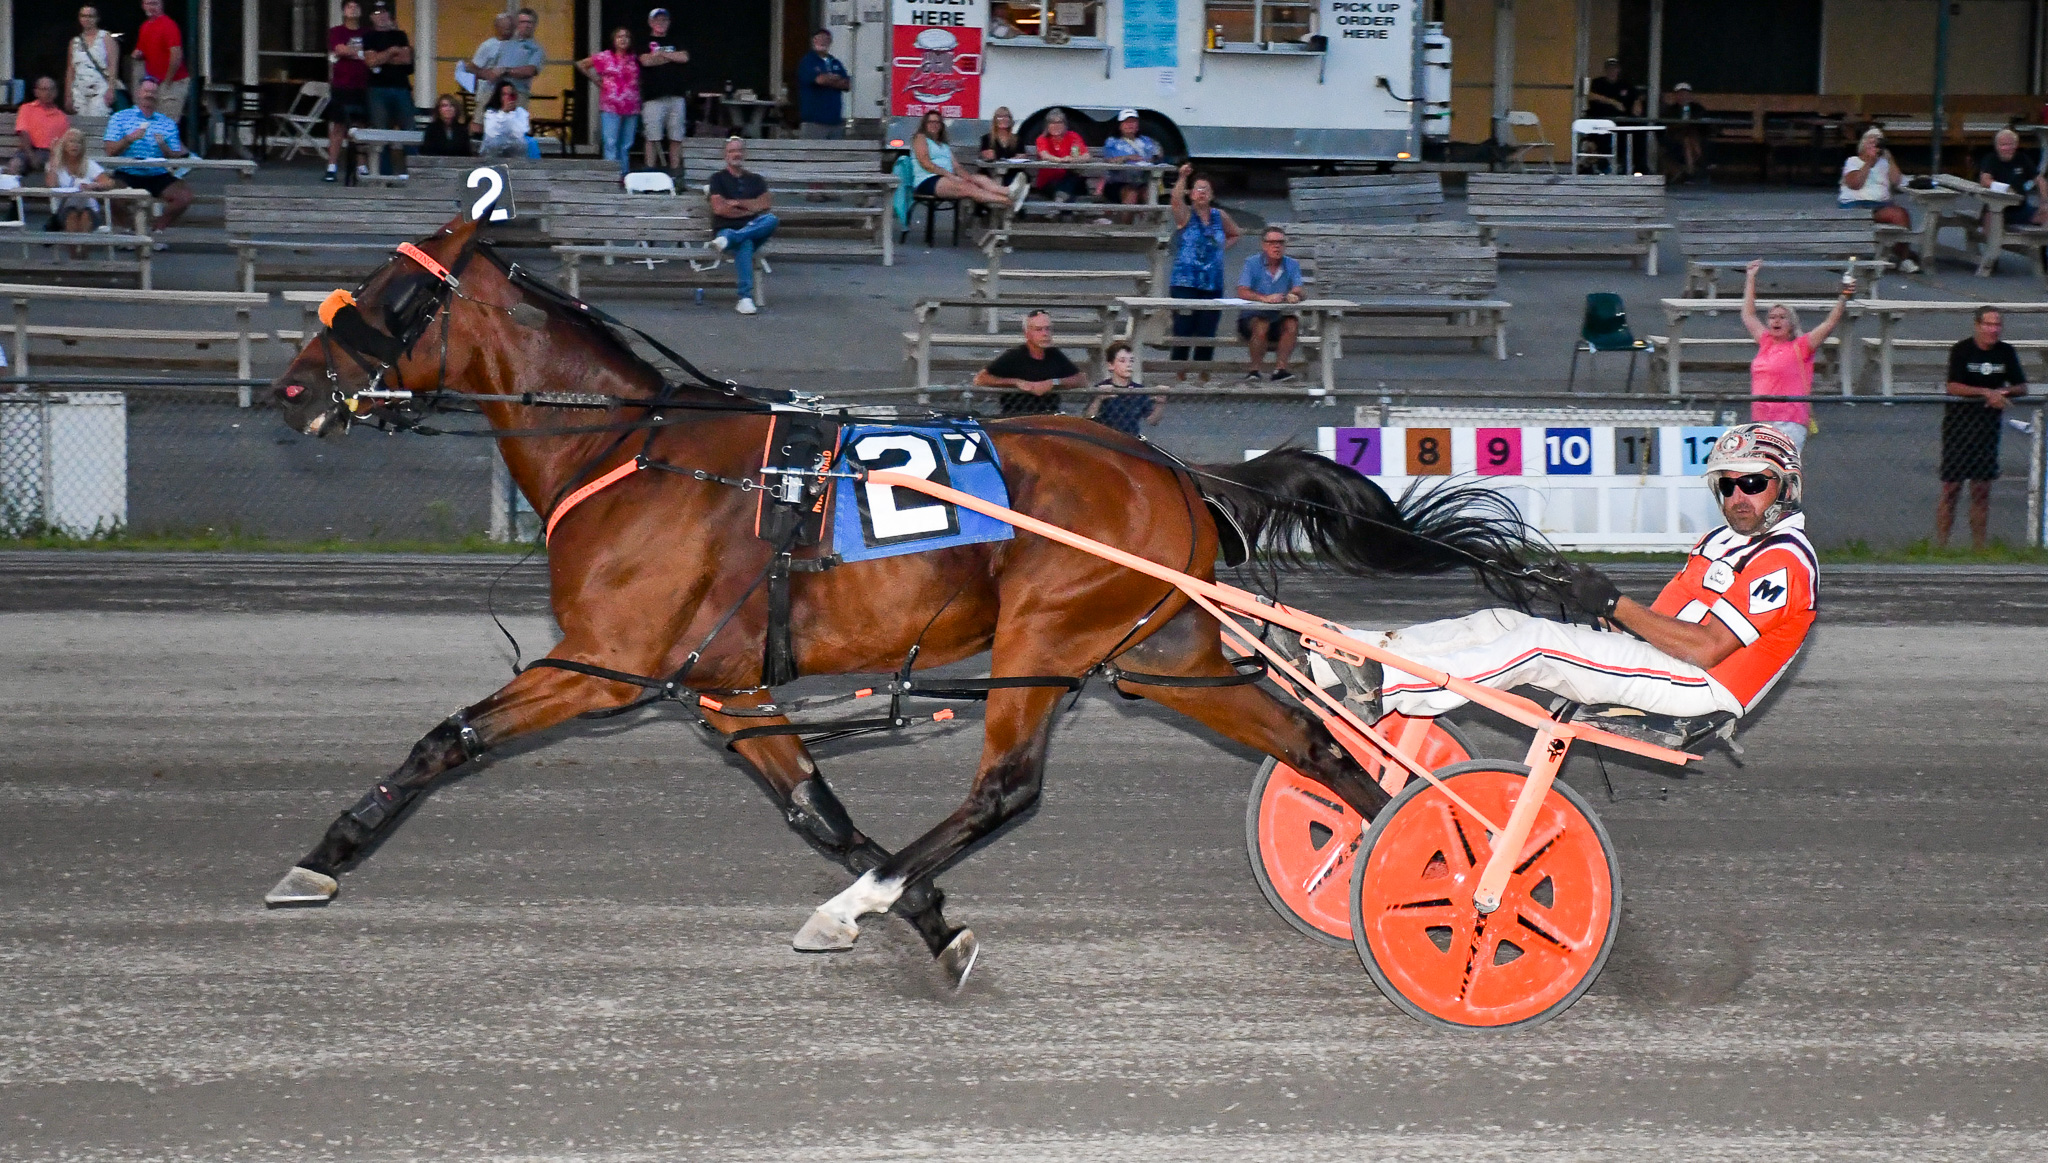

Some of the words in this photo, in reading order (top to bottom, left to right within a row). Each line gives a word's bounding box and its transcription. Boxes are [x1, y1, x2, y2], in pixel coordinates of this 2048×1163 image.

[912, 10, 965, 26] HERE
[1333, 3, 1372, 12] PICK
[1378, 3, 1400, 12] UP
[1336, 16, 1395, 26] ORDER
[1343, 29, 1388, 39] HERE
[467, 167, 508, 221] 2
[942, 432, 981, 462] 7
[1349, 438, 1369, 465] 7
[1418, 437, 1439, 465] 8
[1488, 437, 1509, 465] 9
[1546, 436, 1590, 466] 10
[1622, 436, 1652, 464] 11
[855, 434, 948, 539] 2
[1752, 579, 1785, 603] M
